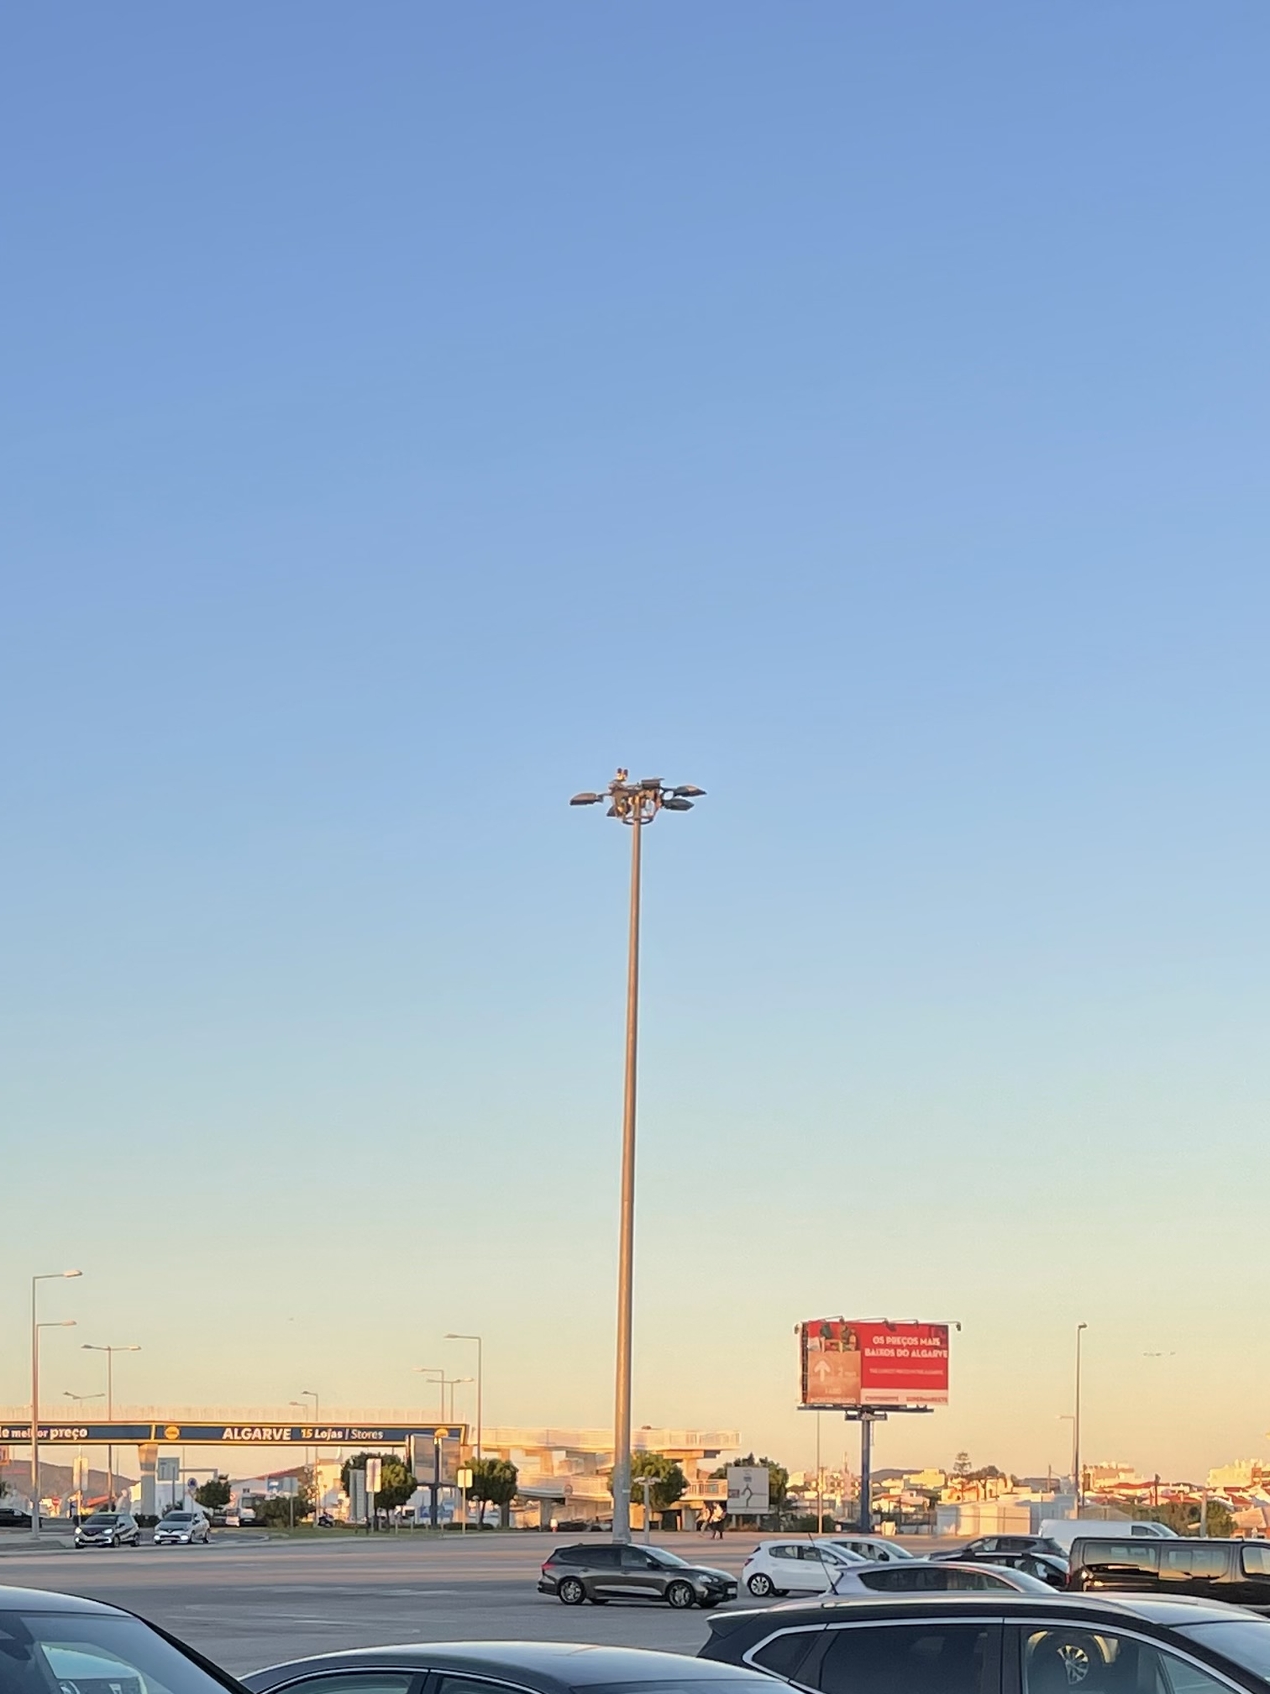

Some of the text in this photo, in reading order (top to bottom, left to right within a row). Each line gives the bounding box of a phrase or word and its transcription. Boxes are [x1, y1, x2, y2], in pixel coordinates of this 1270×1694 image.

[872, 1335, 885, 1345] OS
[11, 1428, 48, 1438] melor
[50, 1428, 88, 1440] preço
[222, 1427, 292, 1440] ALGARVE
[301, 1428, 313, 1439] 15
[315, 1428, 343, 1441] Lojas
[351, 1429, 384, 1440] Stores
